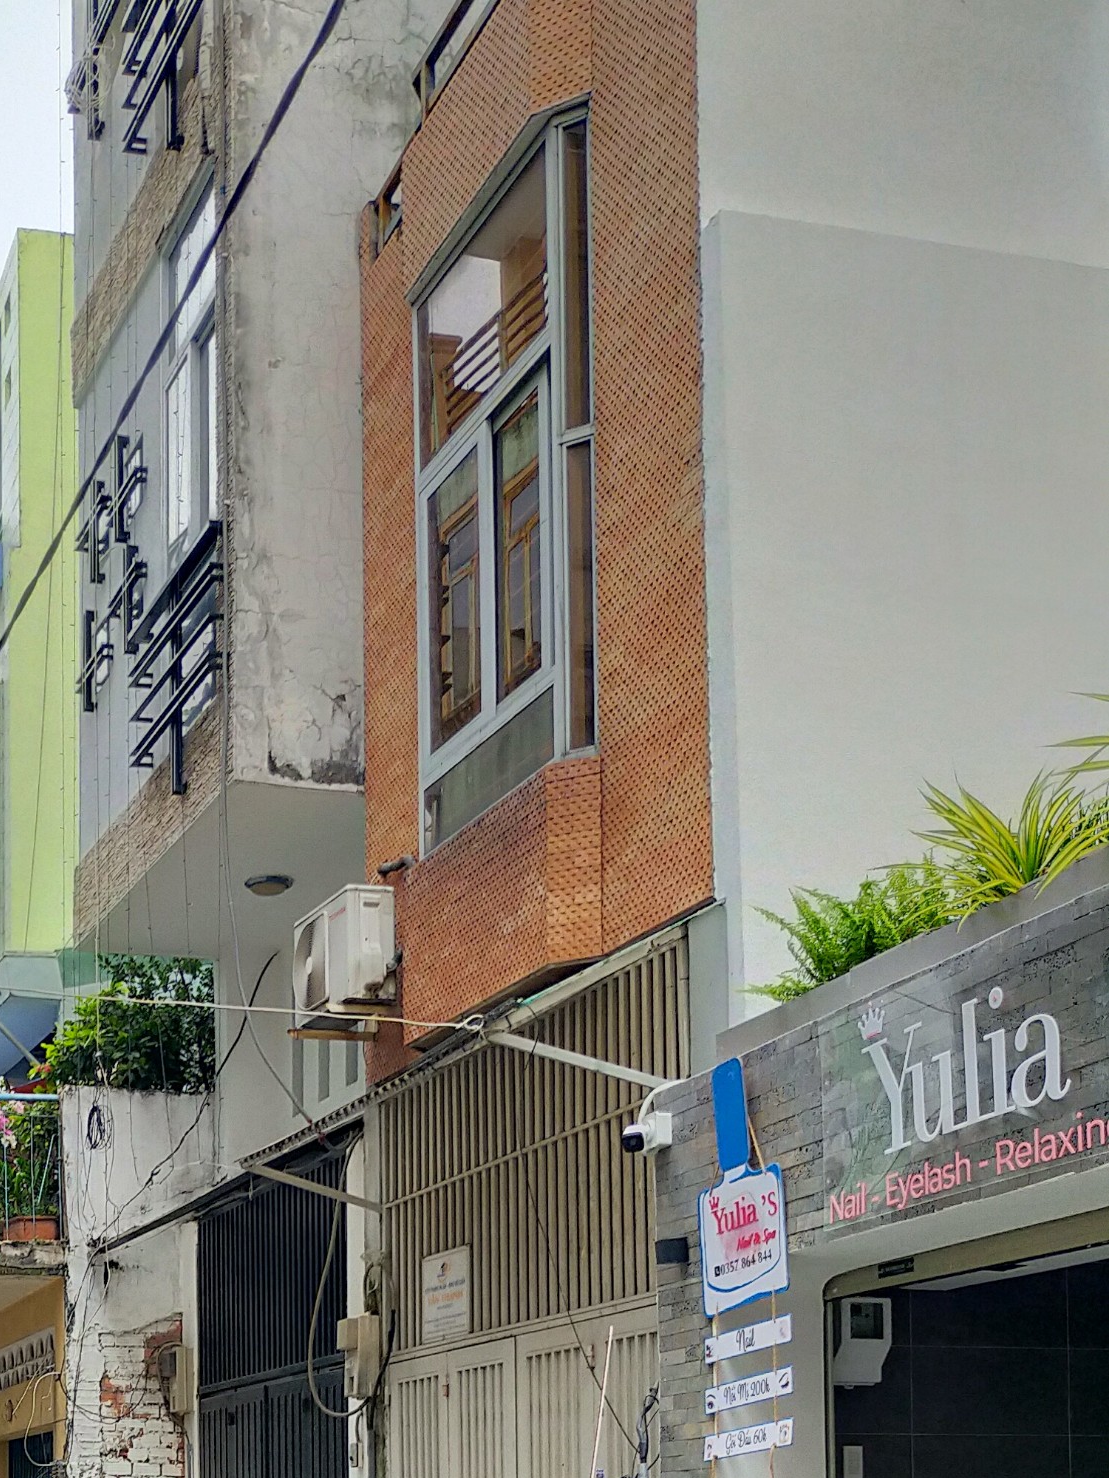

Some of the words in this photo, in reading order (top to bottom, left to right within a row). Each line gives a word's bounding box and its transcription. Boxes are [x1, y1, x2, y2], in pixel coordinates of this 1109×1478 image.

[861, 986, 1072, 1155] Yulia
[829, 1182, 867, 1225] Nail
[885, 1151, 973, 1211] Eyelash
[995, 1111, 1109, 1176] Relaxin
[737, 1233, 754, 1252] Nail
[762, 1227, 777, 1245] Spa
[720, 1258, 739, 1276] 0357
[735, 1327, 756, 1352] Nail
